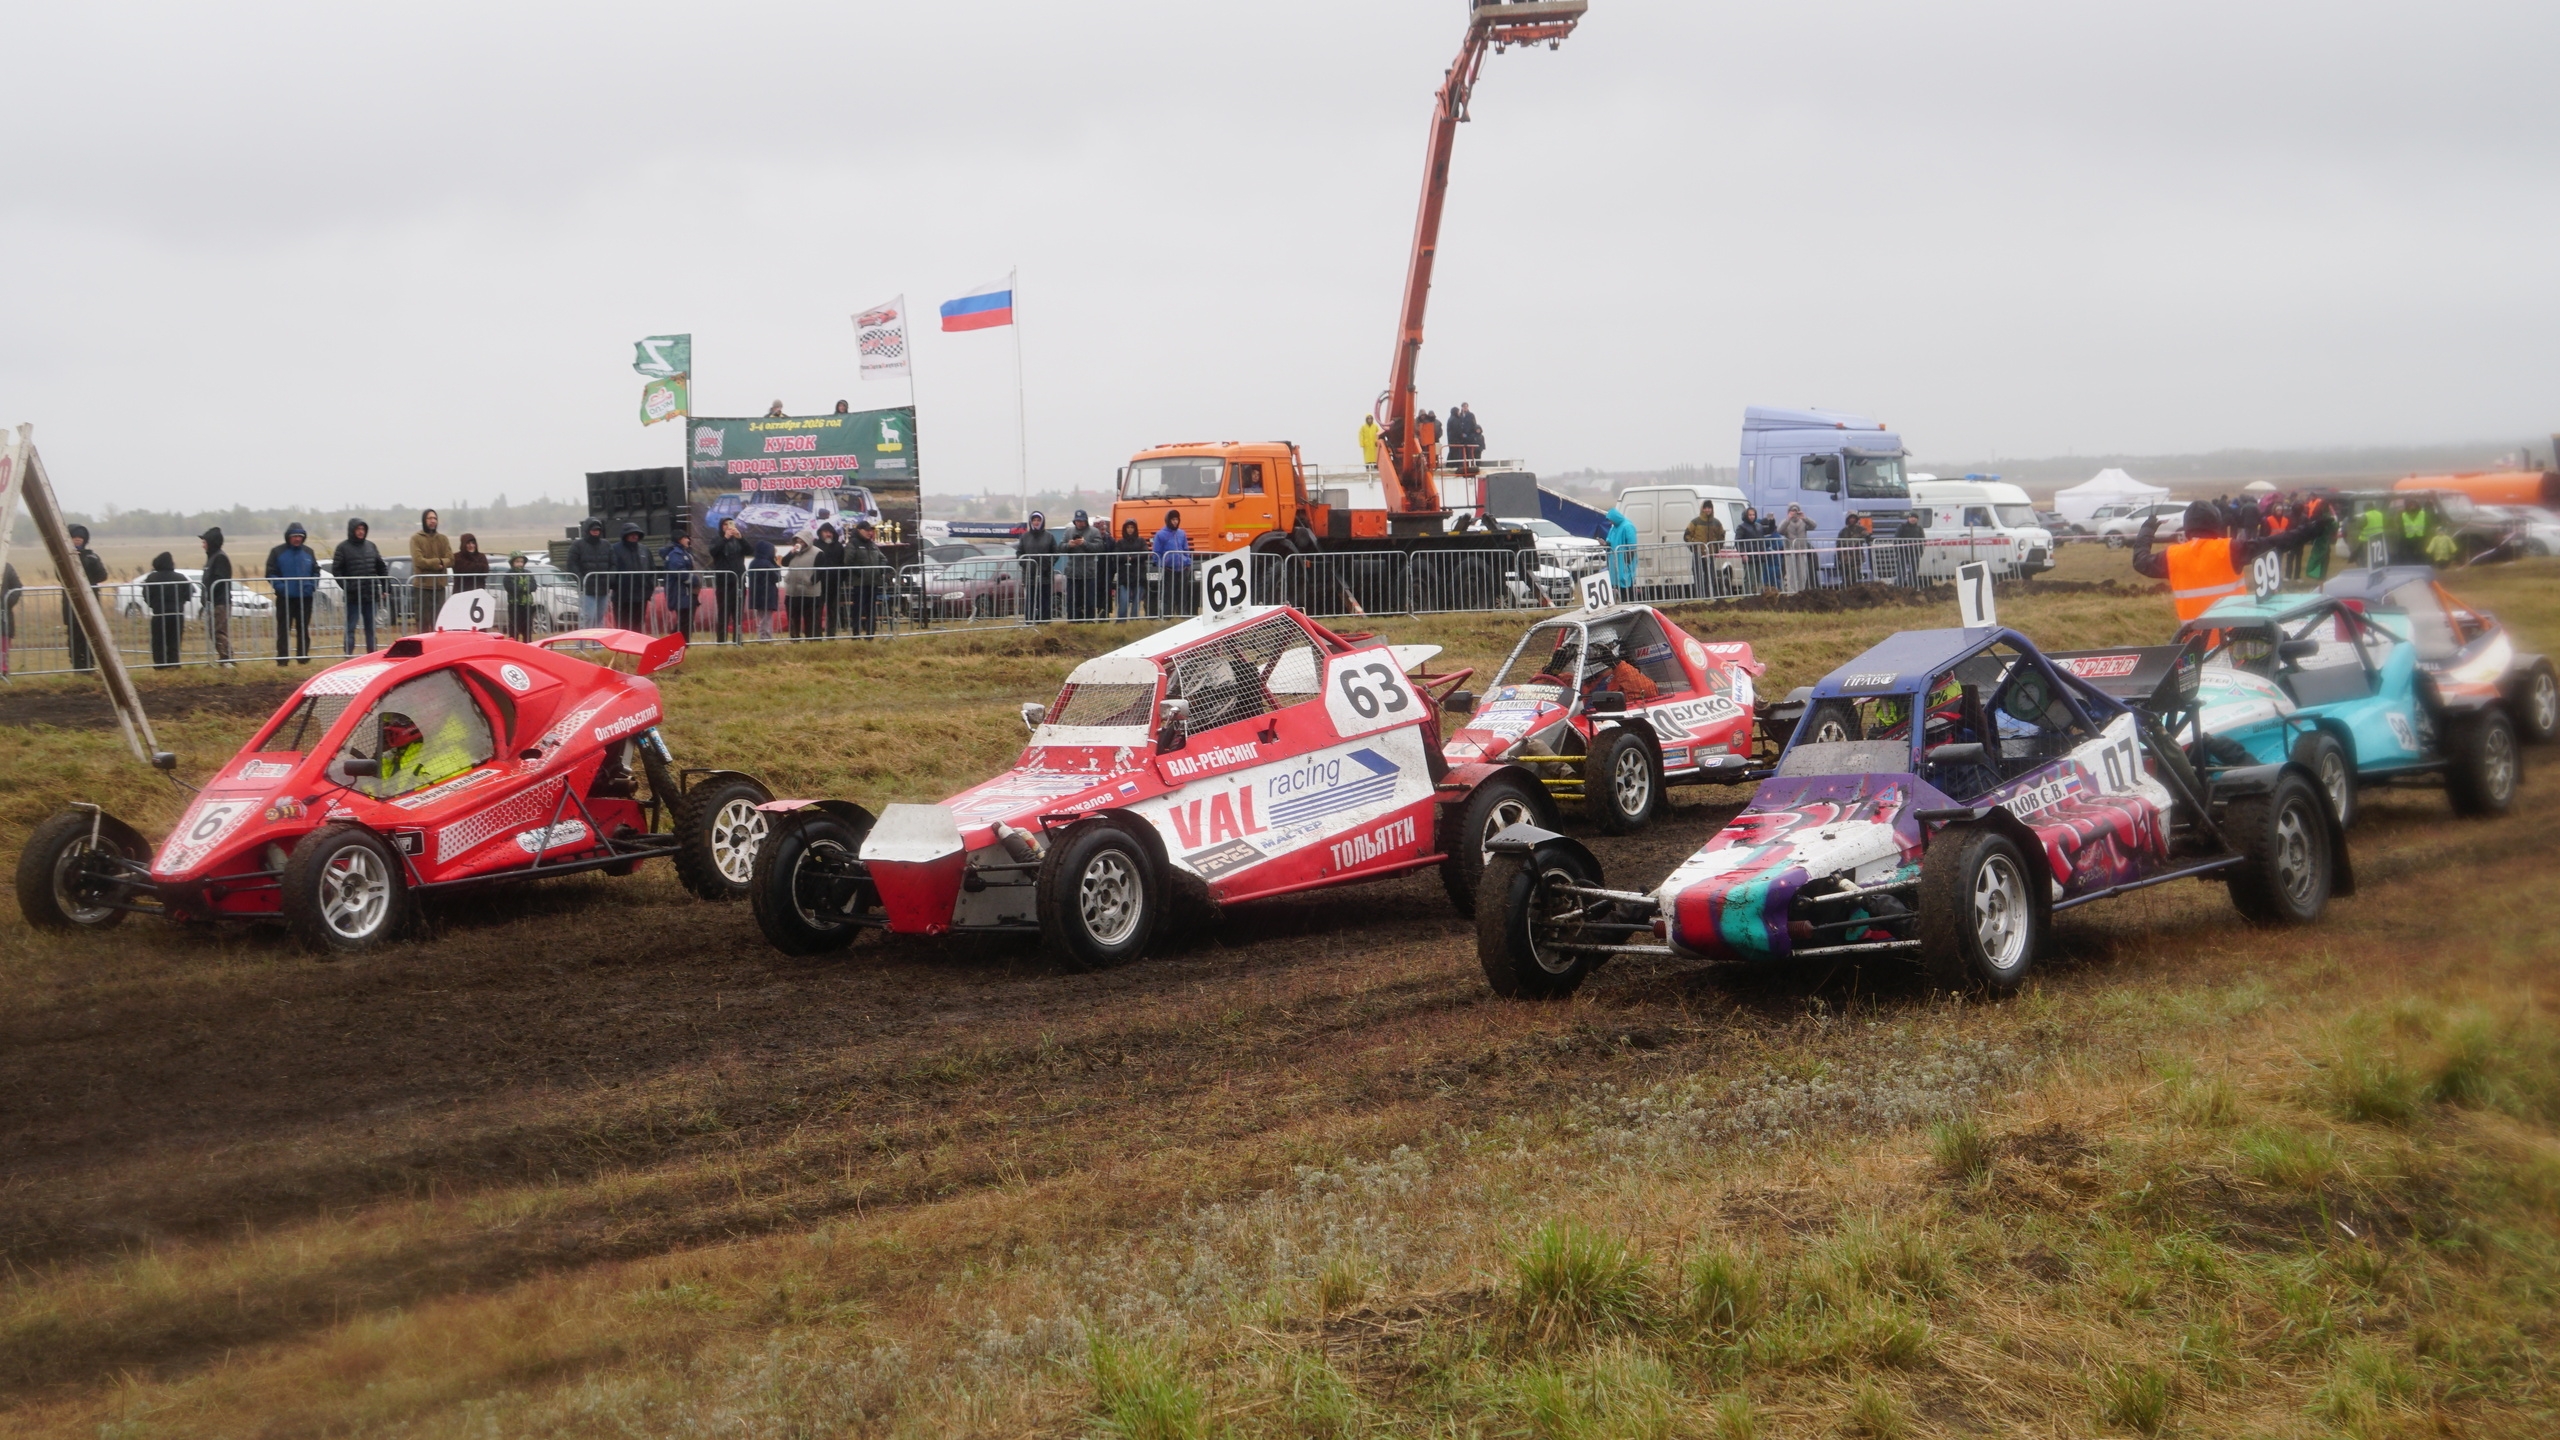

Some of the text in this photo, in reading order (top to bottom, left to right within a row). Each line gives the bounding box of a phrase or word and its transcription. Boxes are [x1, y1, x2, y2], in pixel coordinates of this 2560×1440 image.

[765, 420, 801, 431] октября
[825, 419, 842, 428] год
[764, 435, 817, 452] КУБОК
[728, 458, 778, 475] ГОРОДА
[780, 455, 858, 472] БУЗУЛУКА
[741, 475, 843, 491] ПО АВТОКРОССУ
[1207, 558, 1247, 612] 63
[2253, 550, 2280, 597] 99
[1587, 579, 1610, 610] 50
[1961, 564, 1985, 622] 7
[469, 598, 484, 624] 6
[2069, 655, 2138, 677] SPEED
[1340, 663, 1409, 719] 63
[1491, 700, 1538, 710] БАЛАКОВО
[594, 703, 659, 742] Октябрьский
[1671, 697, 1734, 721] БУСКО
[1166, 742, 1259, 777] ВАЛ-РЕЙСИНГ
[1268, 758, 1341, 798] racing
[191, 806, 232, 841] 6
[1168, 784, 1268, 850] VAL
[1260, 820, 1323, 849] МАСТЕР
[1330, 815, 1416, 872] ТОЛЬЯТТИ
[1193, 843, 1256, 874] FERES
